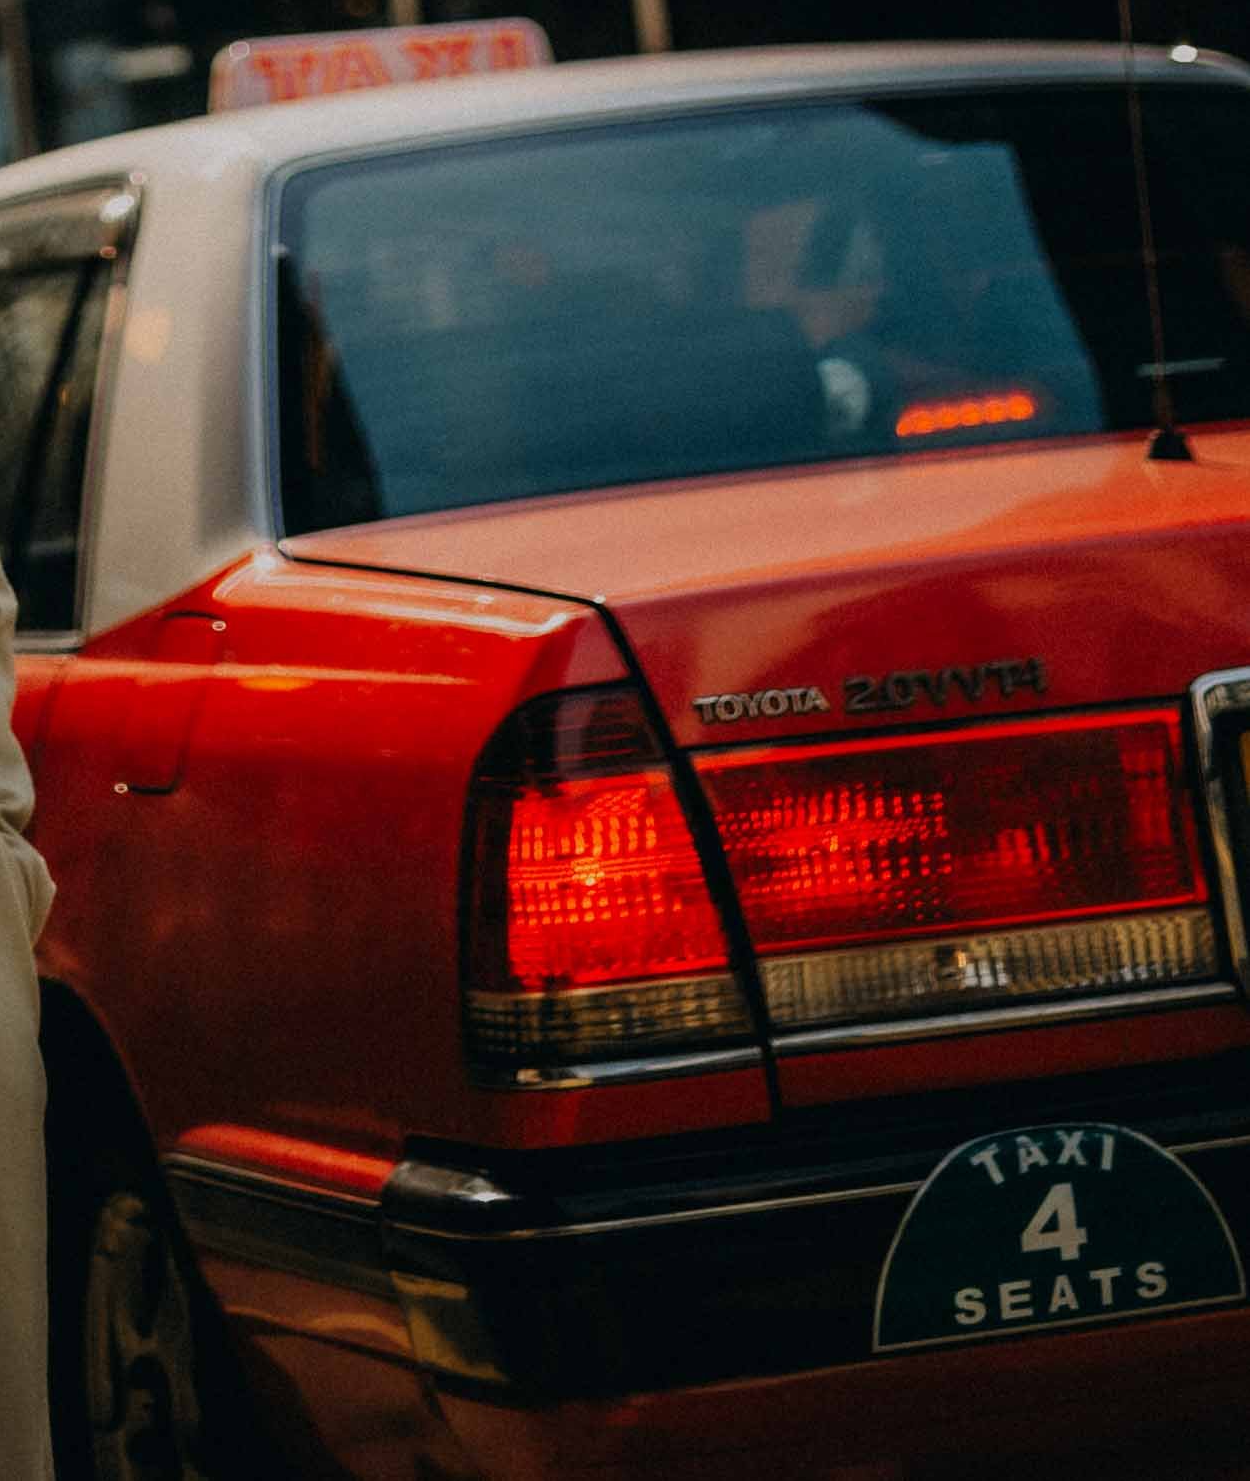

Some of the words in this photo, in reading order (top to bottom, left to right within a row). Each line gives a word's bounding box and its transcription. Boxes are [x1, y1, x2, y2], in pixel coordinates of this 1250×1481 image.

[693, 687, 831, 725] TOYOTA
[970, 1130, 1115, 1185] TAXI
[1020, 1182, 1088, 1261] 4
[954, 1261, 1168, 1325] SEATS
